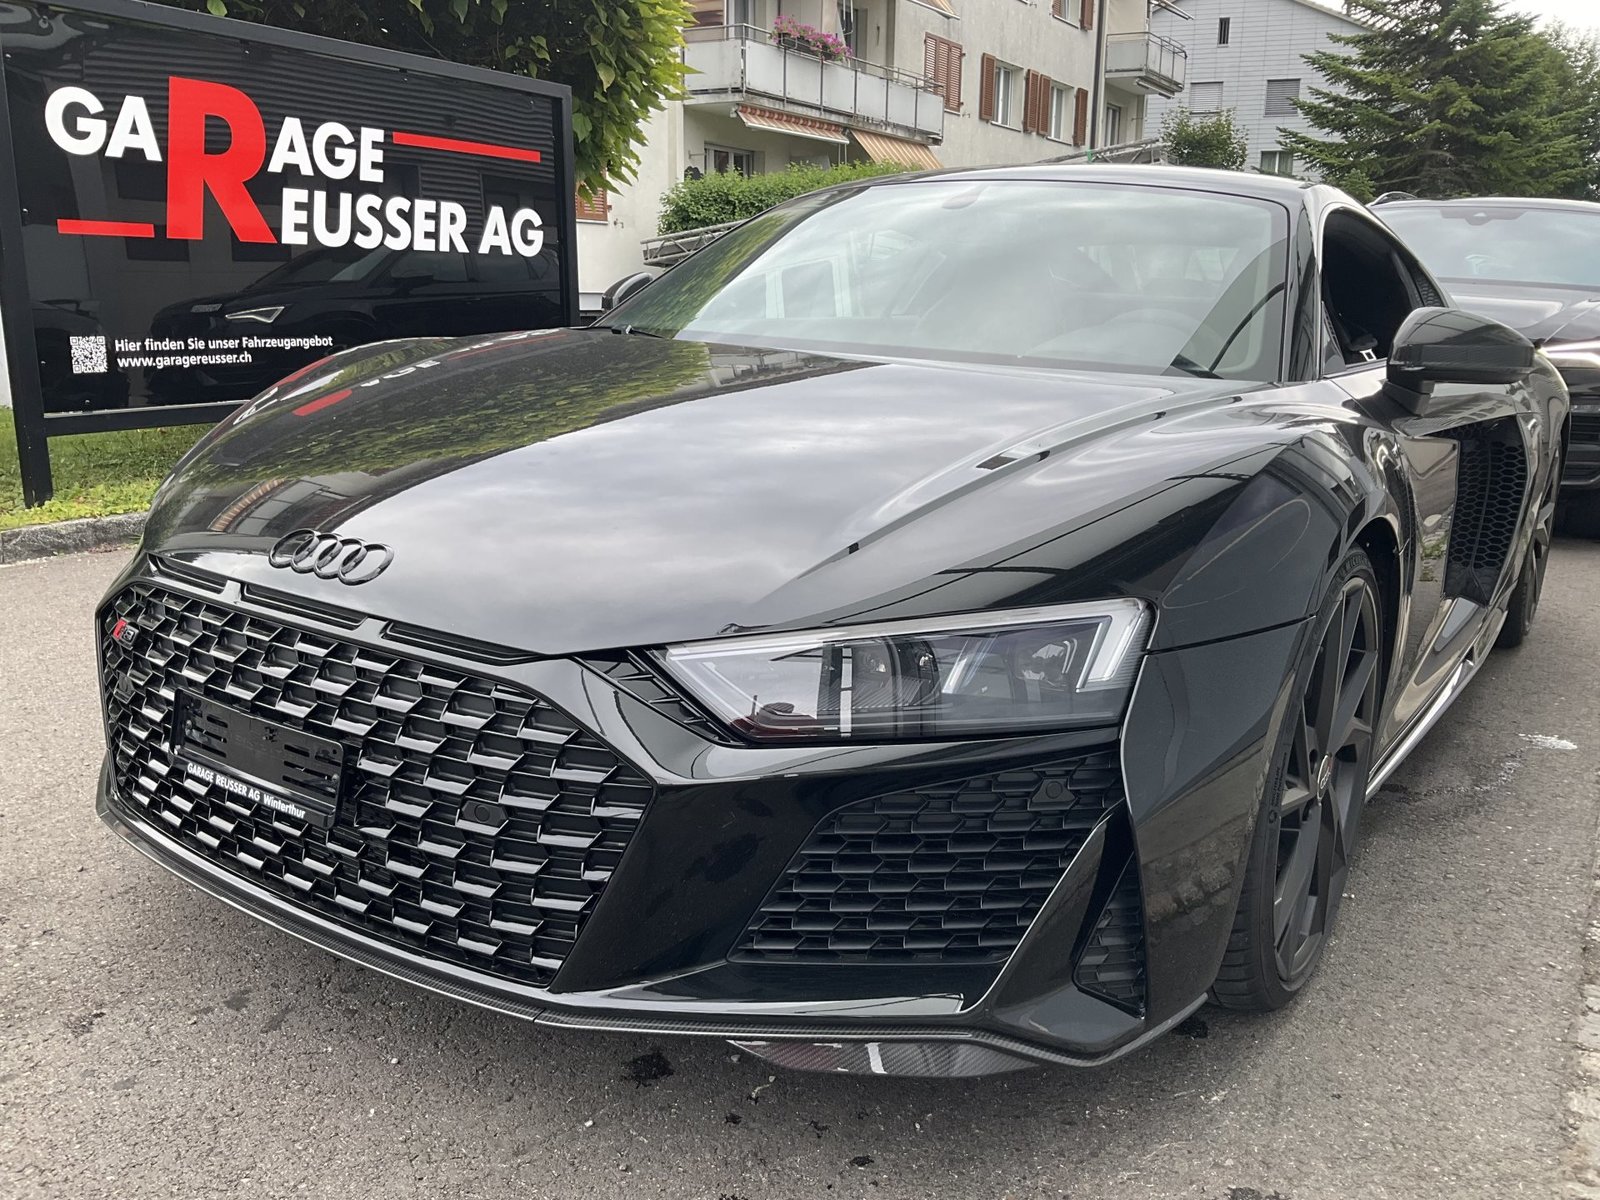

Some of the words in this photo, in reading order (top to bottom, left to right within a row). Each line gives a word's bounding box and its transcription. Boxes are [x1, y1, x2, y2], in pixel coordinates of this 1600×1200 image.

[45, 76, 384, 243] GARAGE
[478, 206, 543, 257] AG
[115, 339, 141, 352] Hier
[144, 338, 185, 351] finden
[187, 337, 206, 350] Sie
[208, 338, 239, 350] unser
[242, 335, 333, 350] Fahrzeugangebot
[117, 351, 252, 369] www.garagereusser.ch
[187, 762, 214, 783] GARAGE
[215, 774, 248, 796] REUSSER
[248, 788, 261, 802] AG
[263, 793, 306, 819] Winterthur
